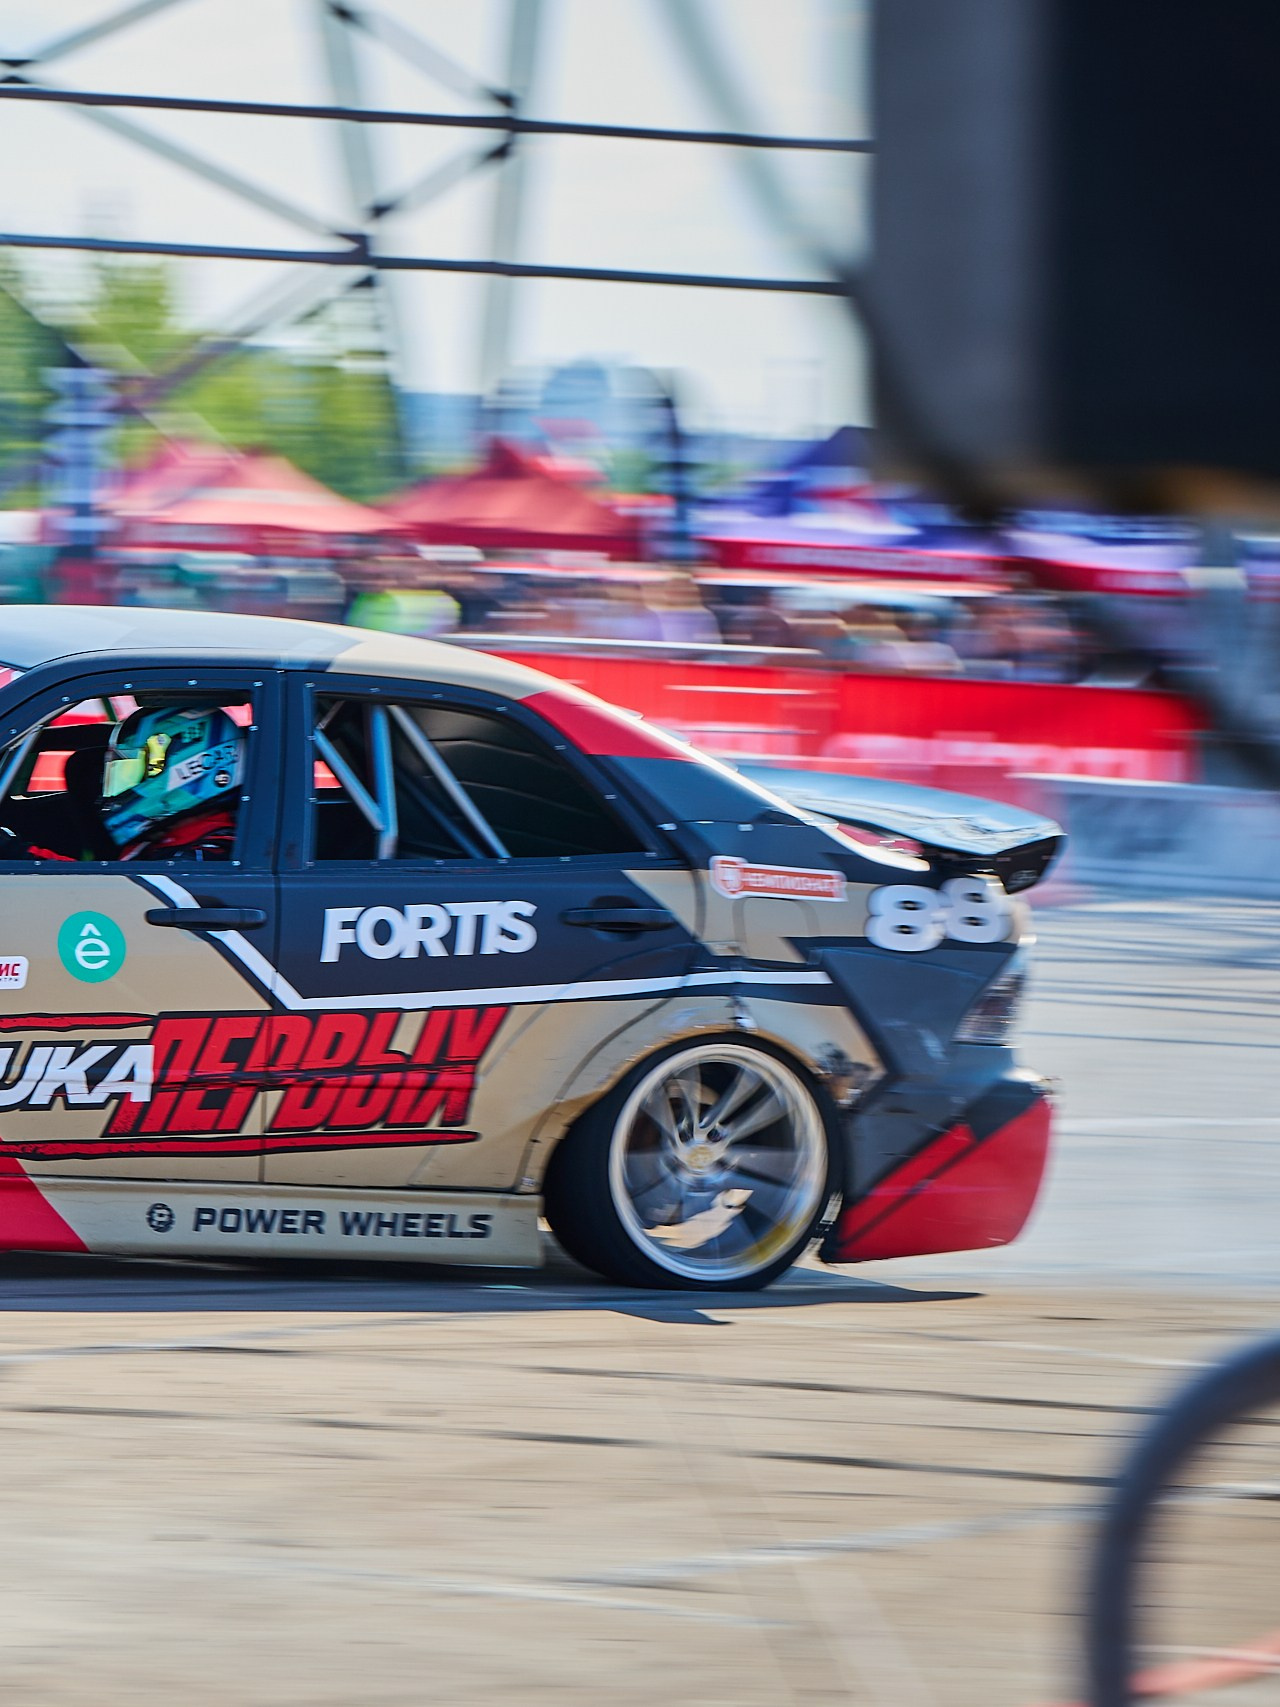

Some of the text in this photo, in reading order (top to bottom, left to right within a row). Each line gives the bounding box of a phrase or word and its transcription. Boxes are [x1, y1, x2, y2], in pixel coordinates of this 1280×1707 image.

[320, 900, 538, 963] FORTIS
[865, 878, 1012, 951] 88
[193, 1206, 494, 1239] POWER WHEELS
